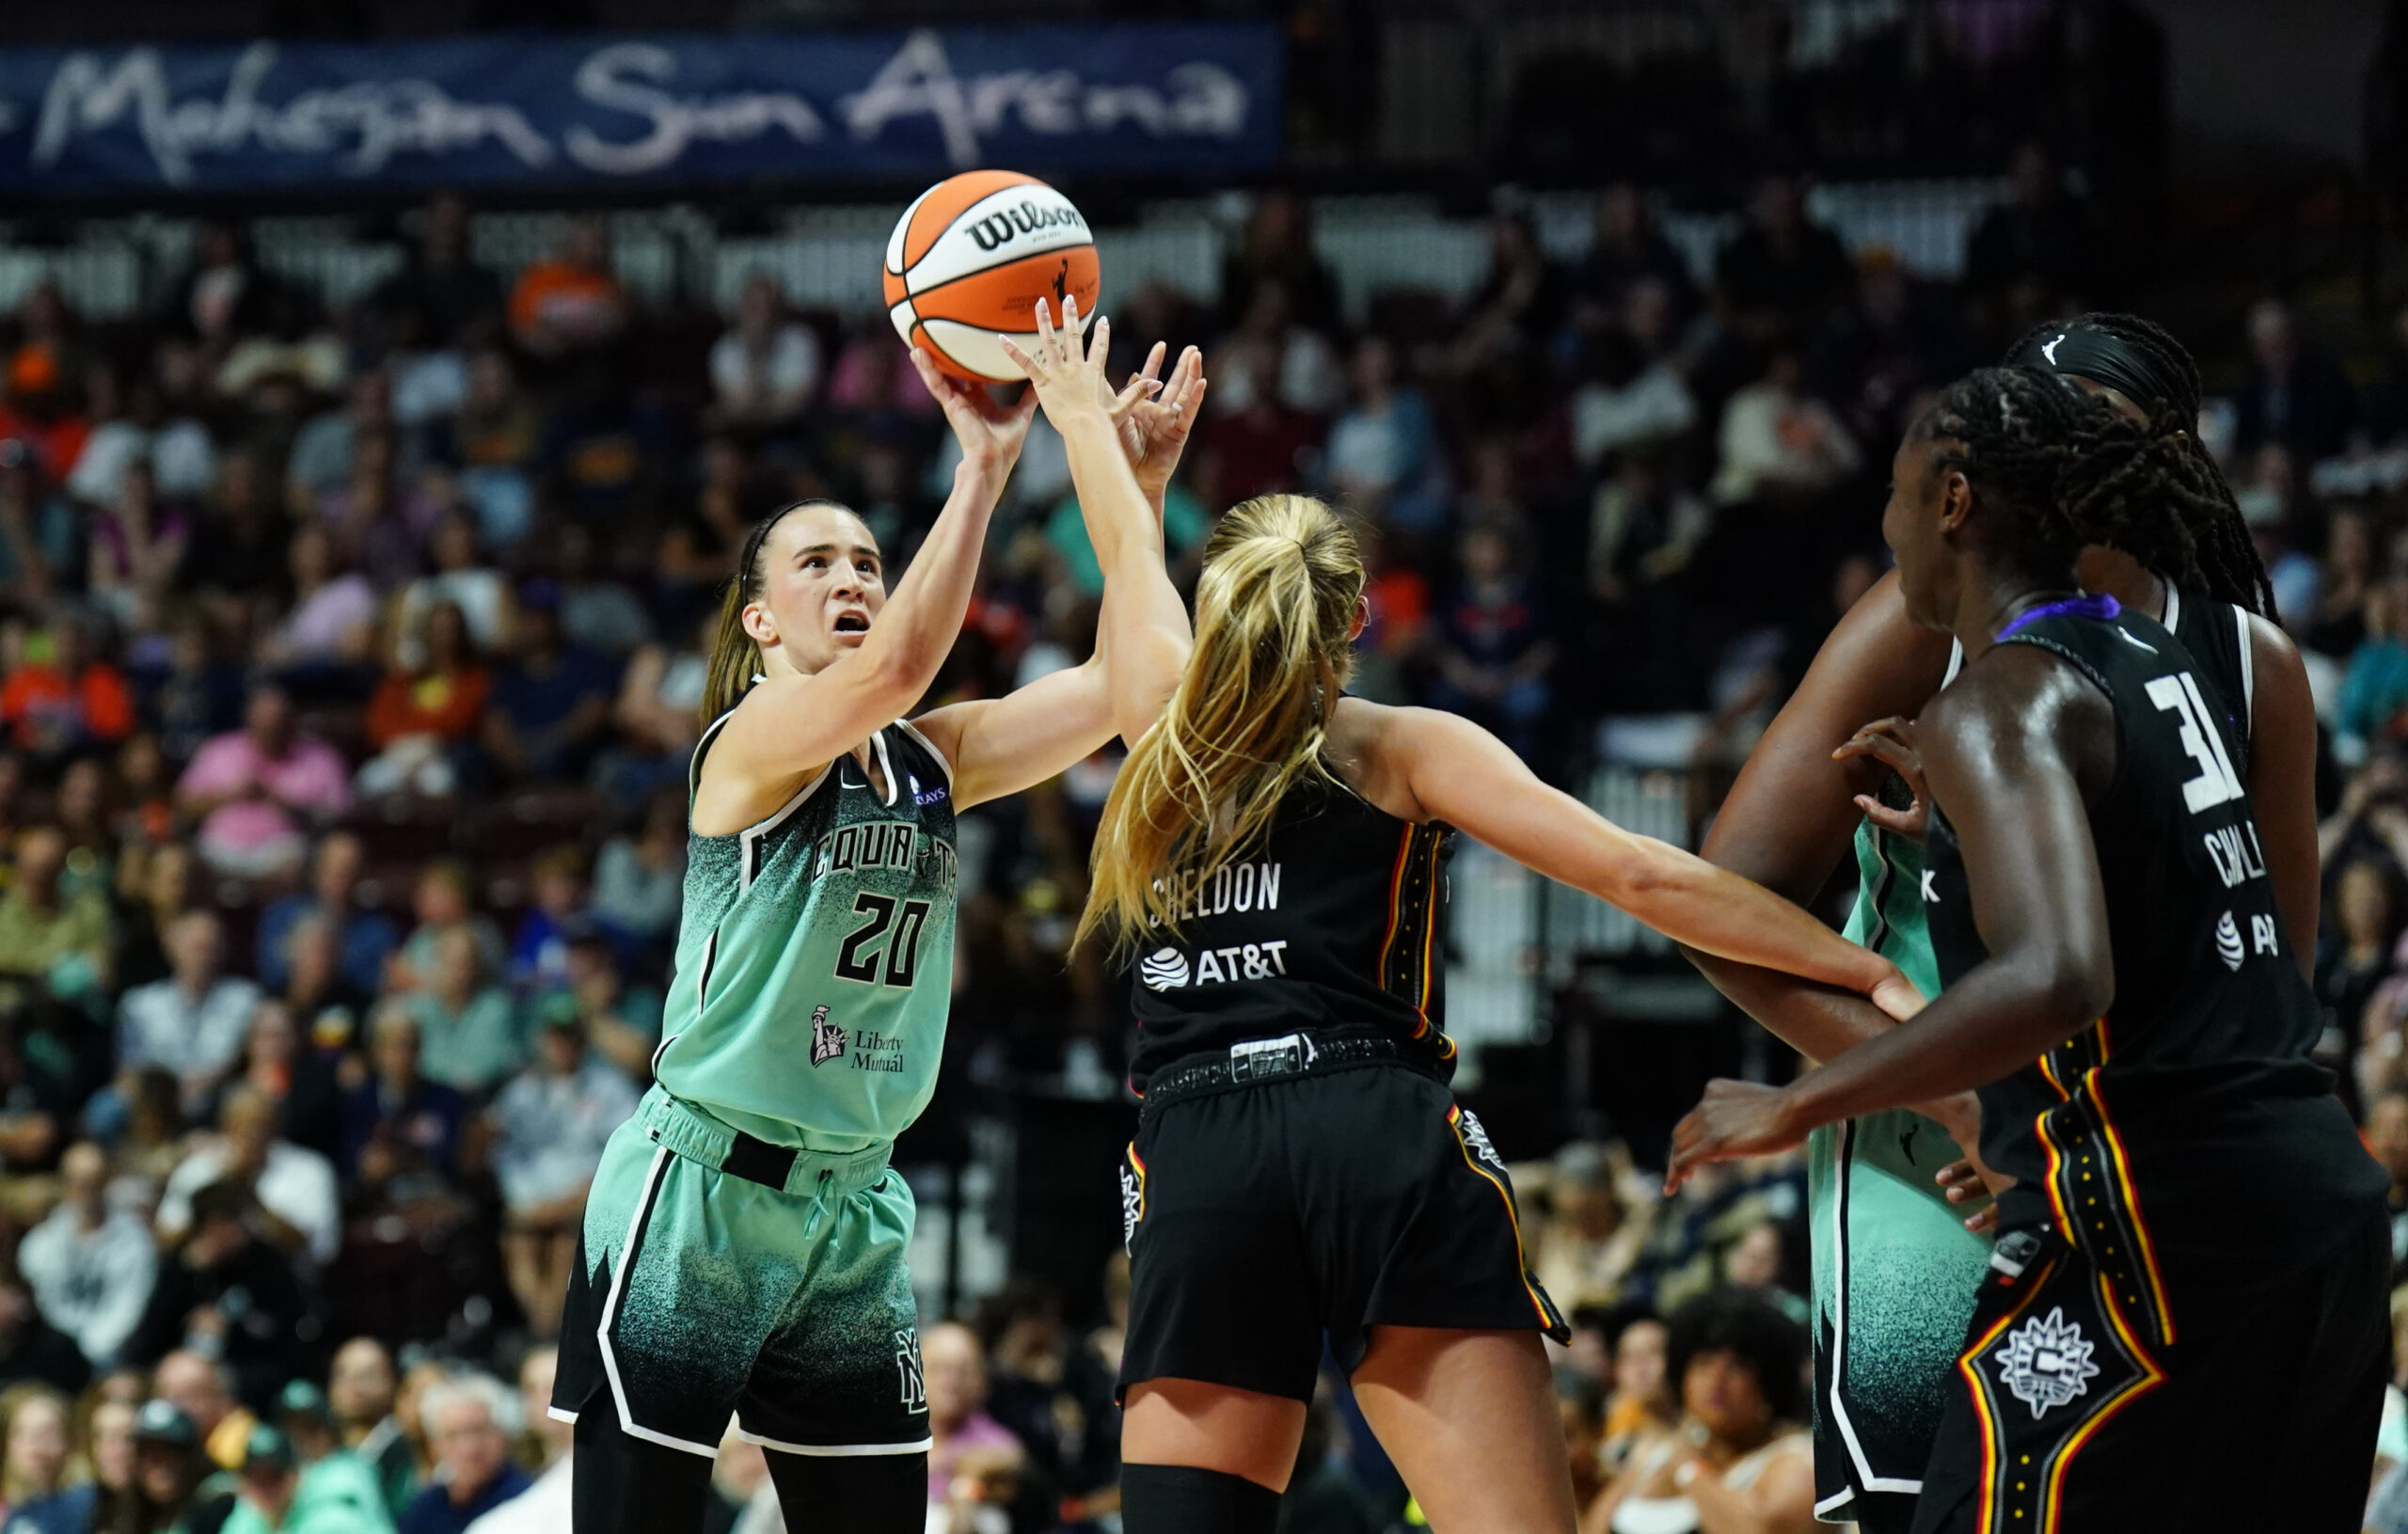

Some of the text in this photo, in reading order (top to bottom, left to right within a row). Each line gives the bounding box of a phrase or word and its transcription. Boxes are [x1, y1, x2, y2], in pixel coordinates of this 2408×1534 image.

[31, 29, 1246, 186] Mohegan Sun Arena
[965, 201, 1087, 251] Wilson
[2145, 672, 2244, 814] 31
[834, 892, 932, 988] 20
[1196, 941, 1288, 986] AT&T
[850, 1052, 903, 1073] Mutual
[854, 1030, 903, 1056] Liberty
